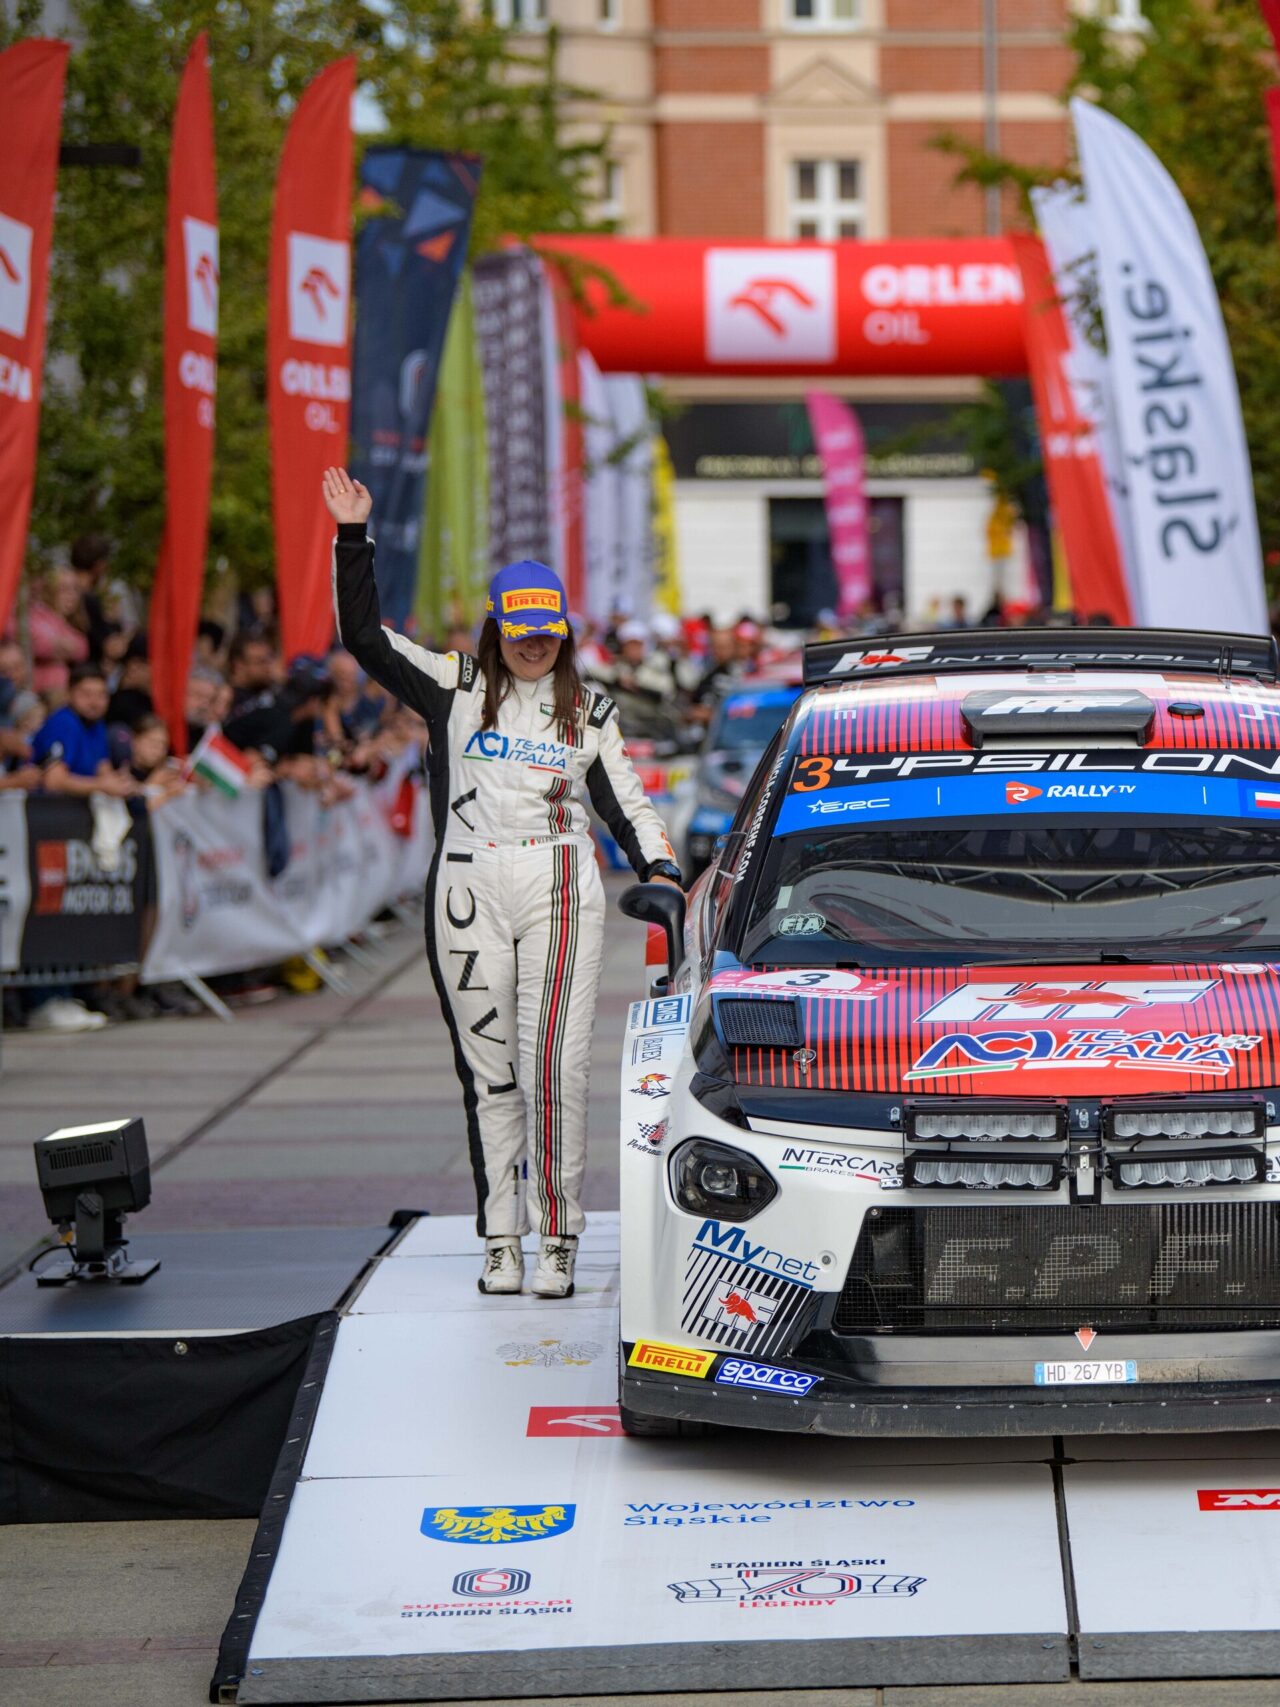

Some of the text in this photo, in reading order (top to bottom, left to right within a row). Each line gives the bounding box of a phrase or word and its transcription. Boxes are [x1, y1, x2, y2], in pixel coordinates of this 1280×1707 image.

[861, 264, 1024, 306] ORLEN
[863, 312, 930, 344] OIL
[505, 593, 559, 609] PIRELLI
[464, 731, 509, 760] ACI
[514, 738, 564, 755] TEAM
[506, 750, 567, 769] ITALIA
[793, 756, 834, 792] 3
[780, 916, 820, 933] FIA
[446, 786, 518, 1096] LANCIA
[785, 972, 831, 987] 3
[1067, 1028, 1219, 1046] TEAM
[911, 1029, 1057, 1071] ACI
[1052, 1042, 1236, 1068] ITALIA
[782, 1147, 895, 1176] INTERCAR
[805, 1166, 855, 1177] BRAKES
[695, 1219, 821, 1281] Mynet
[636, 1344, 707, 1373] PIRELLI
[722, 1360, 813, 1388] sparco
[1047, 1363, 1124, 1382] HD 267 YB
[624, 1499, 916, 1513] Województwo
[623, 1514, 772, 1527] Śląskie
[710, 1558, 886, 1569] STADION ŚLĄSKI
[400, 1606, 573, 1618] STADION ŚLĄSKI
[401, 1599, 574, 1610] superauto.pl
[738, 1600, 837, 1608] LEGENDY
